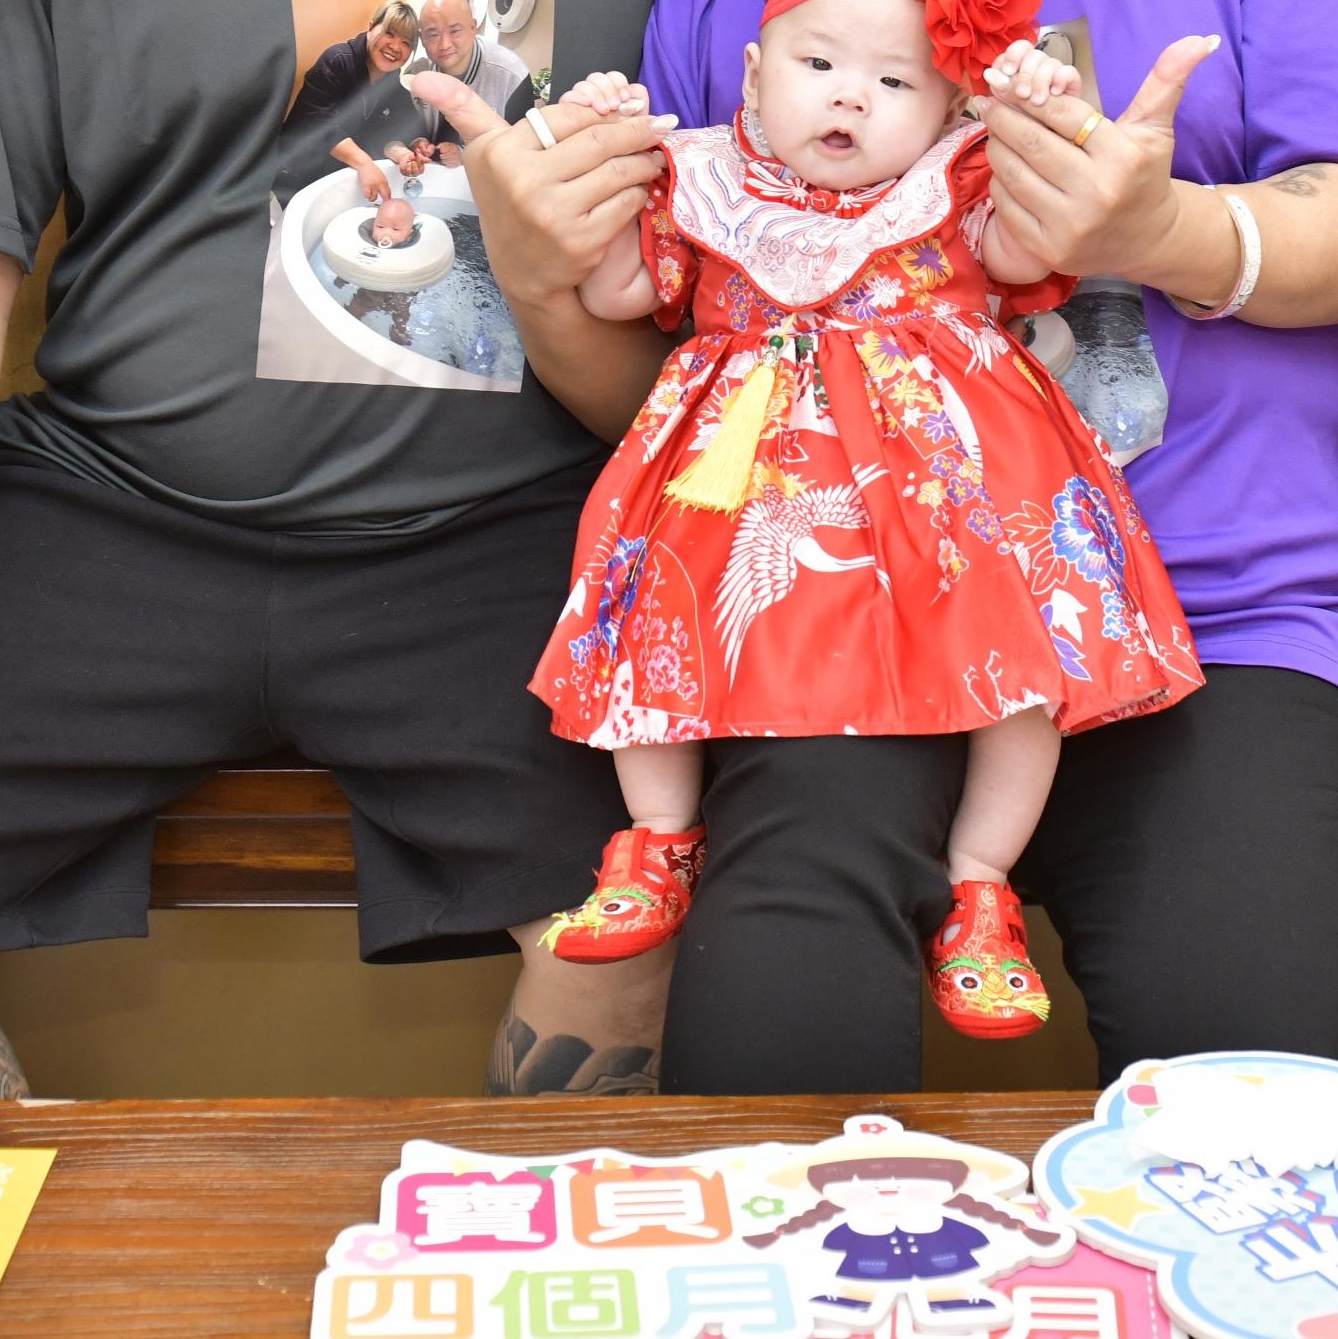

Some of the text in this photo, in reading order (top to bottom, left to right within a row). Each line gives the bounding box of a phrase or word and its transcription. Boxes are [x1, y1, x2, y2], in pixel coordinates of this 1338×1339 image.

[415, 1179, 722, 1245] 寶貝
[330, 1262, 798, 1339] 四個月
